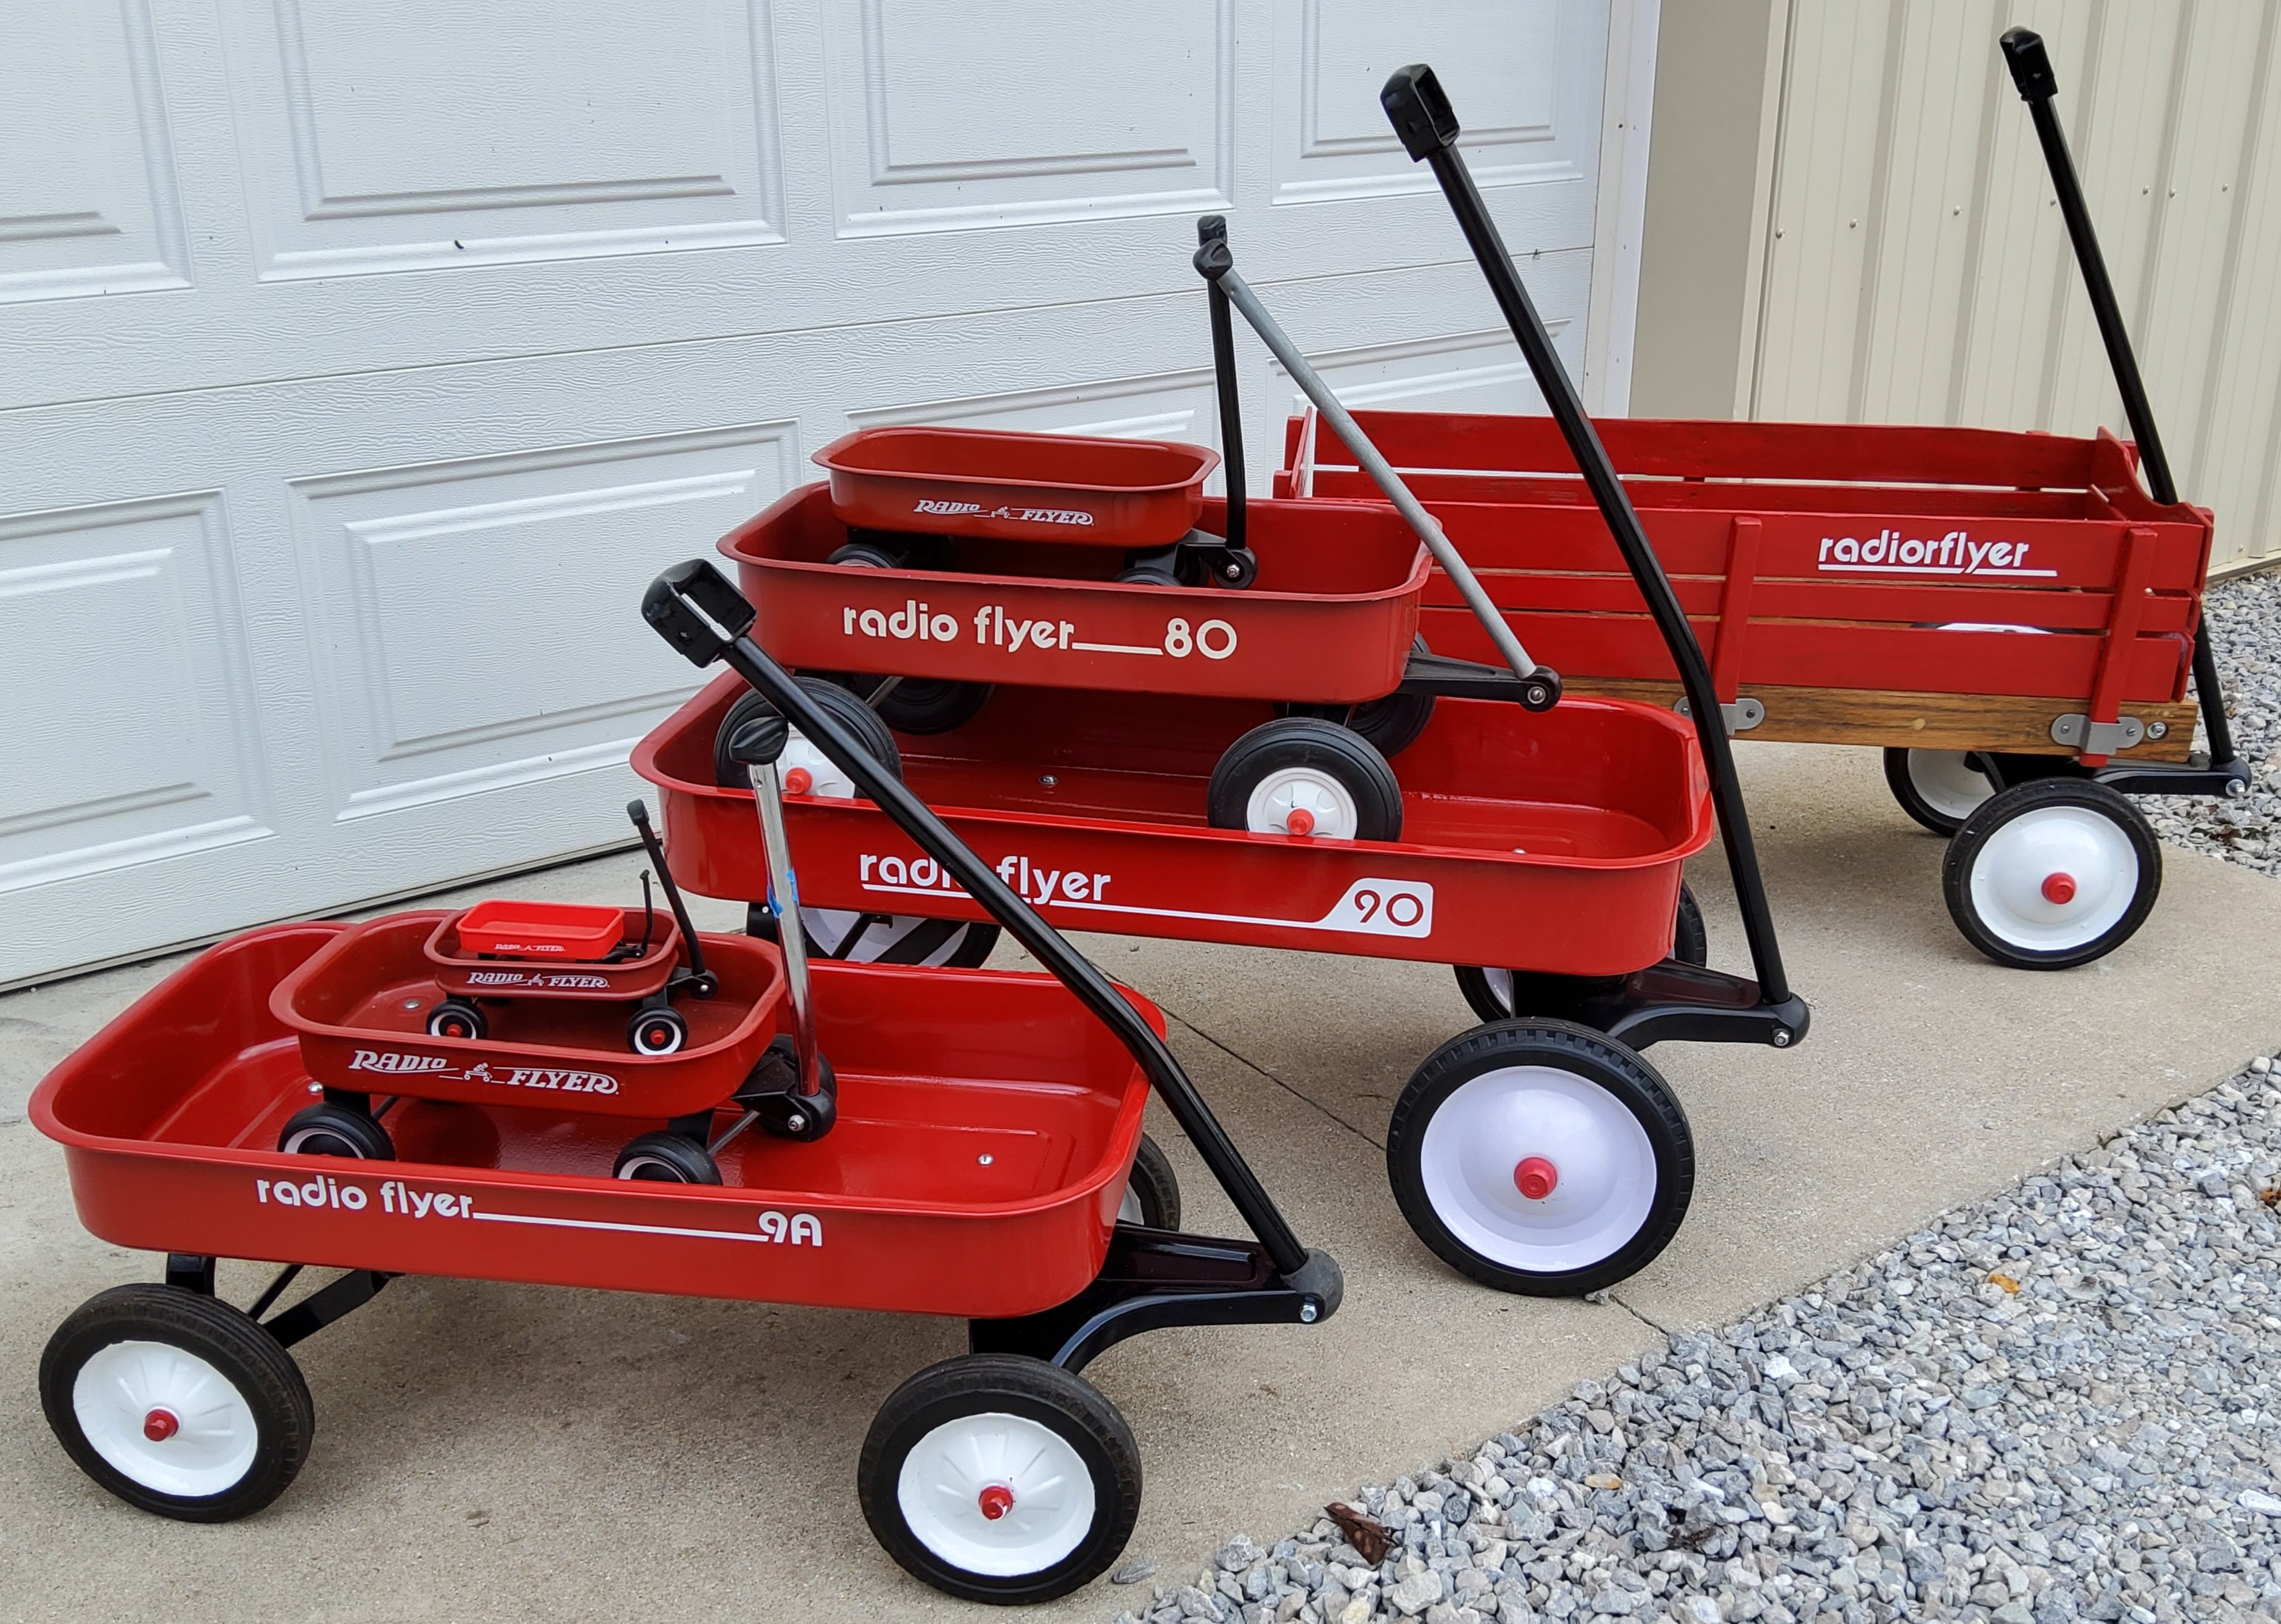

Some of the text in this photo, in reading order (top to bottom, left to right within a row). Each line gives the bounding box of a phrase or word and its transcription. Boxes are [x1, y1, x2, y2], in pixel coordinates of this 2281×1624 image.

[914, 500, 1093, 526] RADIO FLYER
[843, 600, 1237, 659] radio flyer 80
[860, 854, 1424, 926] radi flyer 90
[466, 972, 608, 987] RADIO FLYER
[349, 1050, 619, 1094] RADIO FLYER
[257, 1174, 822, 1247] radio flyer 9A
